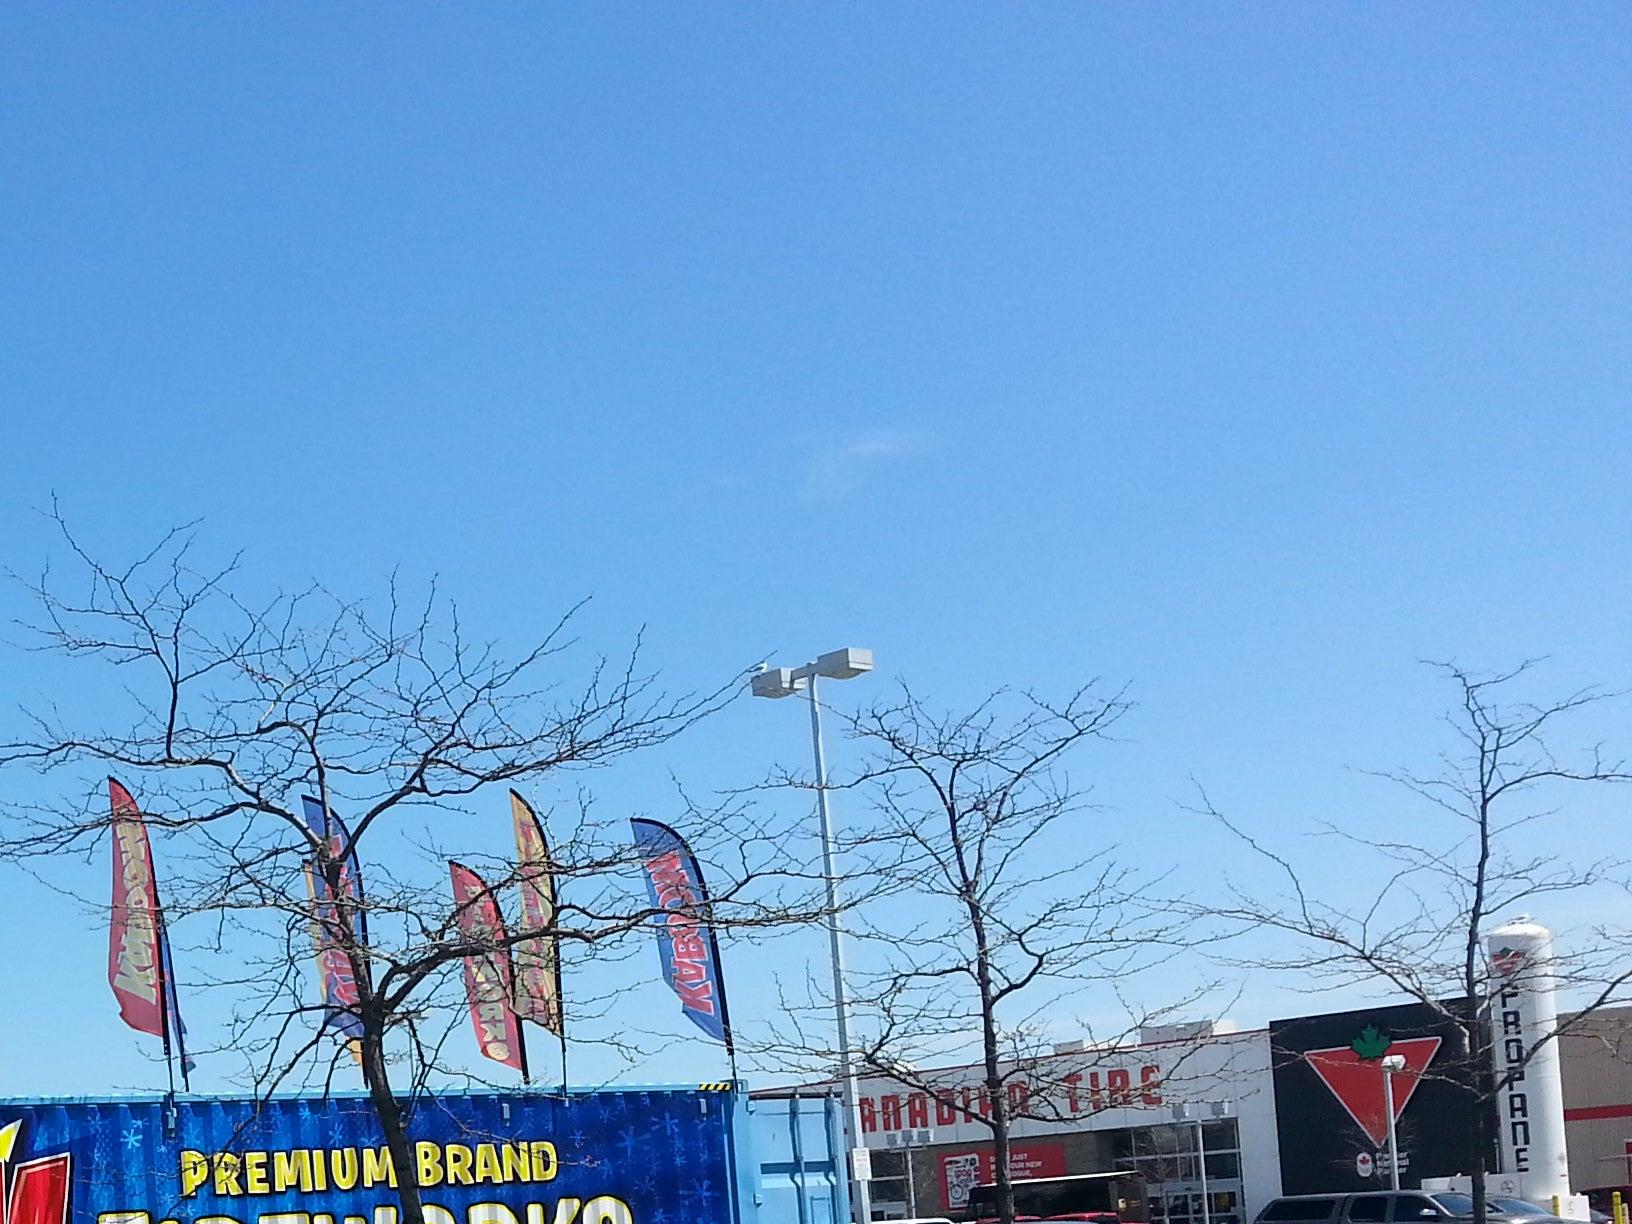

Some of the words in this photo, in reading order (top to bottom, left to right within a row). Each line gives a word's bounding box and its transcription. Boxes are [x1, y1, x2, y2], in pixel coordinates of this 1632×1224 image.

[858, 1080, 1031, 1133] ANADIAN
[1063, 1065, 1163, 1113] TIRE
[1500, 984, 1530, 1173] PROPANE
[180, 1146, 399, 1197] PREMIUM
[415, 1141, 558, 1187] BRAND
